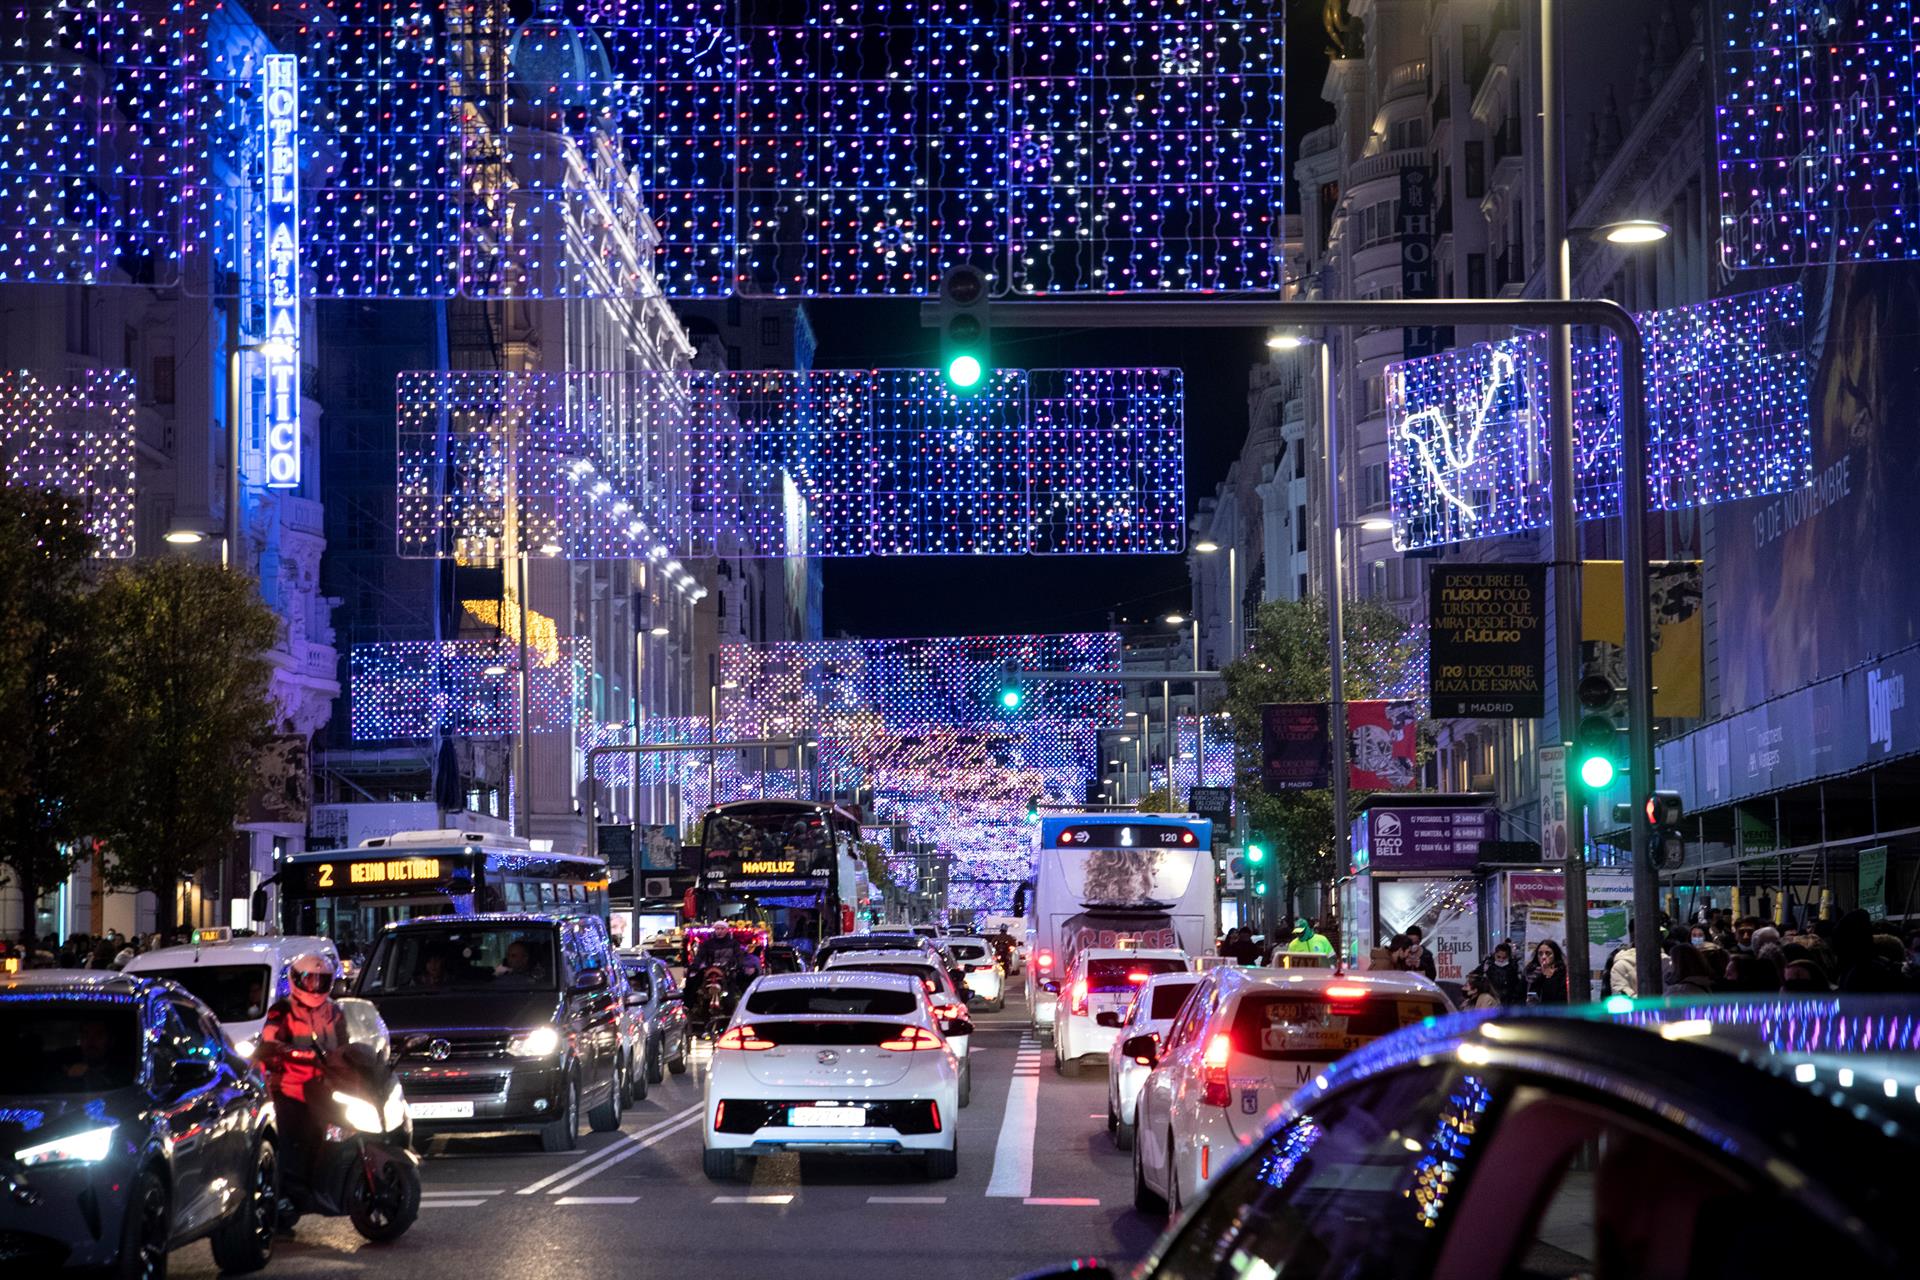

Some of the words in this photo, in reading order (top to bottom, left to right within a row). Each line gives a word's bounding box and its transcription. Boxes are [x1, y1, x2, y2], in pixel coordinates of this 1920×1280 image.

[268, 60, 294, 202] HOTEL
[1402, 214, 1430, 347] HOTL
[1752, 511, 1764, 550] 19
[1767, 500, 1782, 543] DE
[1784, 454, 1850, 532] NOVIEMBRE
[1446, 575, 1510, 587] DESCUBRE
[1514, 575, 1527, 587] EL
[1494, 588, 1530, 600] POLO
[1503, 602, 1532, 616] QUE
[1435, 617, 1465, 629] MIRA
[1467, 617, 1508, 629] DESDE
[1511, 616, 1538, 629] HOY
[1468, 665, 1534, 678] DESCUBRE
[1435, 680, 1469, 692] PLAZA
[1472, 680, 1488, 692] DE
[1491, 678, 1539, 692] ESPAÑA
[1471, 703, 1514, 713] MADRID
[1160, 833, 1177, 842] 120
[1374, 838, 1403, 847] TACO
[1376, 847, 1403, 856] BELL
[319, 864, 333, 887] 2
[351, 862, 385, 883] REINA
[387, 859, 439, 881] VICTORIA
[742, 862, 795, 873] NAVILUZ
[730, 880, 806, 889] madrid.city-tour.com
[1438, 953, 1453, 965] GET
[1439, 966, 1462, 978] BACK
